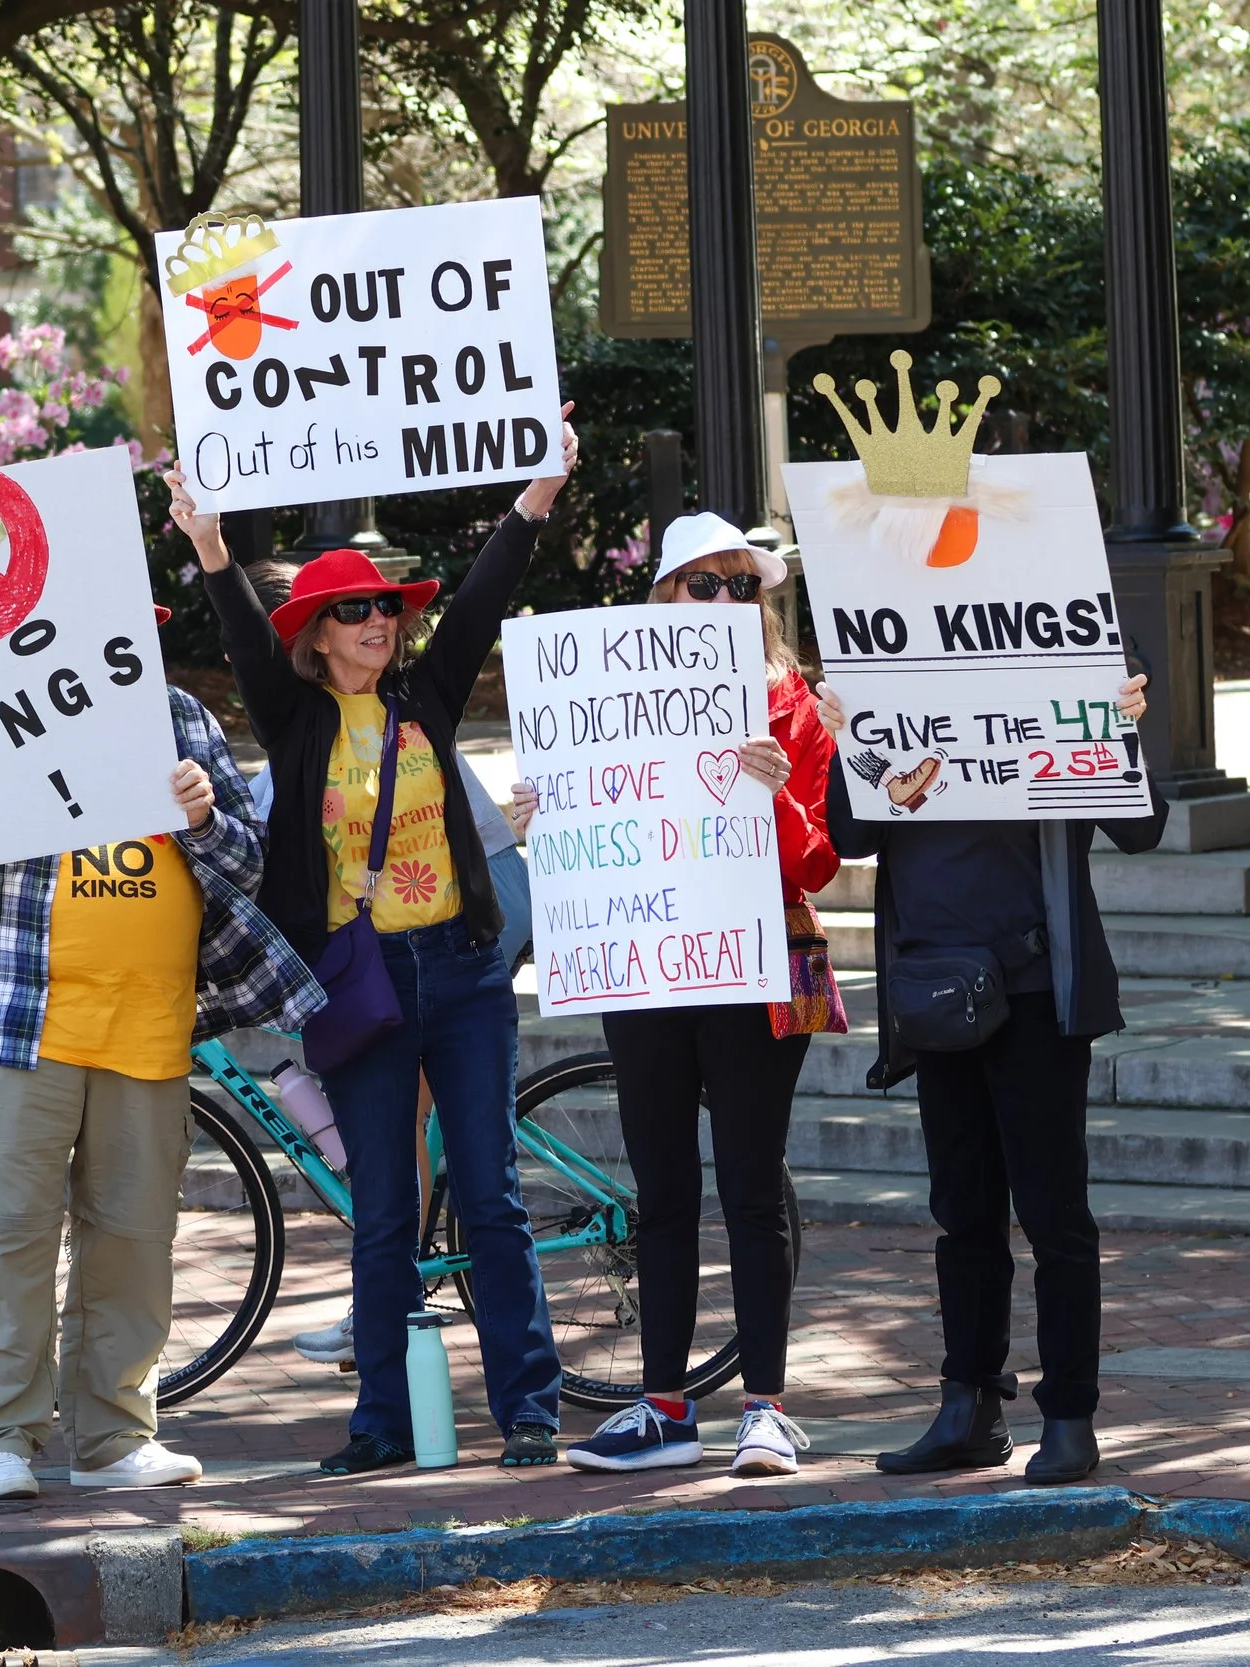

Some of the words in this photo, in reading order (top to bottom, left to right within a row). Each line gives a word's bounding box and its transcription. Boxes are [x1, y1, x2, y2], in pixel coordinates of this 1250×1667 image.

[765, 119, 795, 138] OF
[803, 117, 900, 138] GEORGIA
[310, 267, 405, 323] OUT
[431, 258, 513, 312] OF
[205, 341, 533, 411] CONTROL
[195, 430, 274, 491] Out
[289, 422, 318, 471] of
[335, 428, 379, 465] his
[401, 416, 548, 478] MIND
[832, 607, 908, 655] NO
[933, 592, 1121, 652] KINGS!
[537, 632, 578, 683] NO
[603, 623, 739, 675] KINGS!
[518, 704, 557, 754] NO
[570, 683, 752, 748] DICTATORS!
[850, 710, 958, 751] GIVE
[973, 713, 1045, 746] THE
[1050, 699, 1135, 741] 47t
[589, 760, 666, 807] LOVE
[949, 758, 1020, 785] THE
[71, 840, 154, 877] NO
[531, 819, 642, 877] KINDNESS
[661, 815, 773, 862] DIVERSITY
[71, 879, 157, 899] KINGS
[544, 898, 599, 934] WILL
[606, 887, 679, 927] MAKE
[547, 939, 647, 998] AMERICA
[222, 1057, 313, 1160] TREK
[158, 1354, 208, 1387] ECTION
[561, 1371, 644, 1393] NTRAGE
